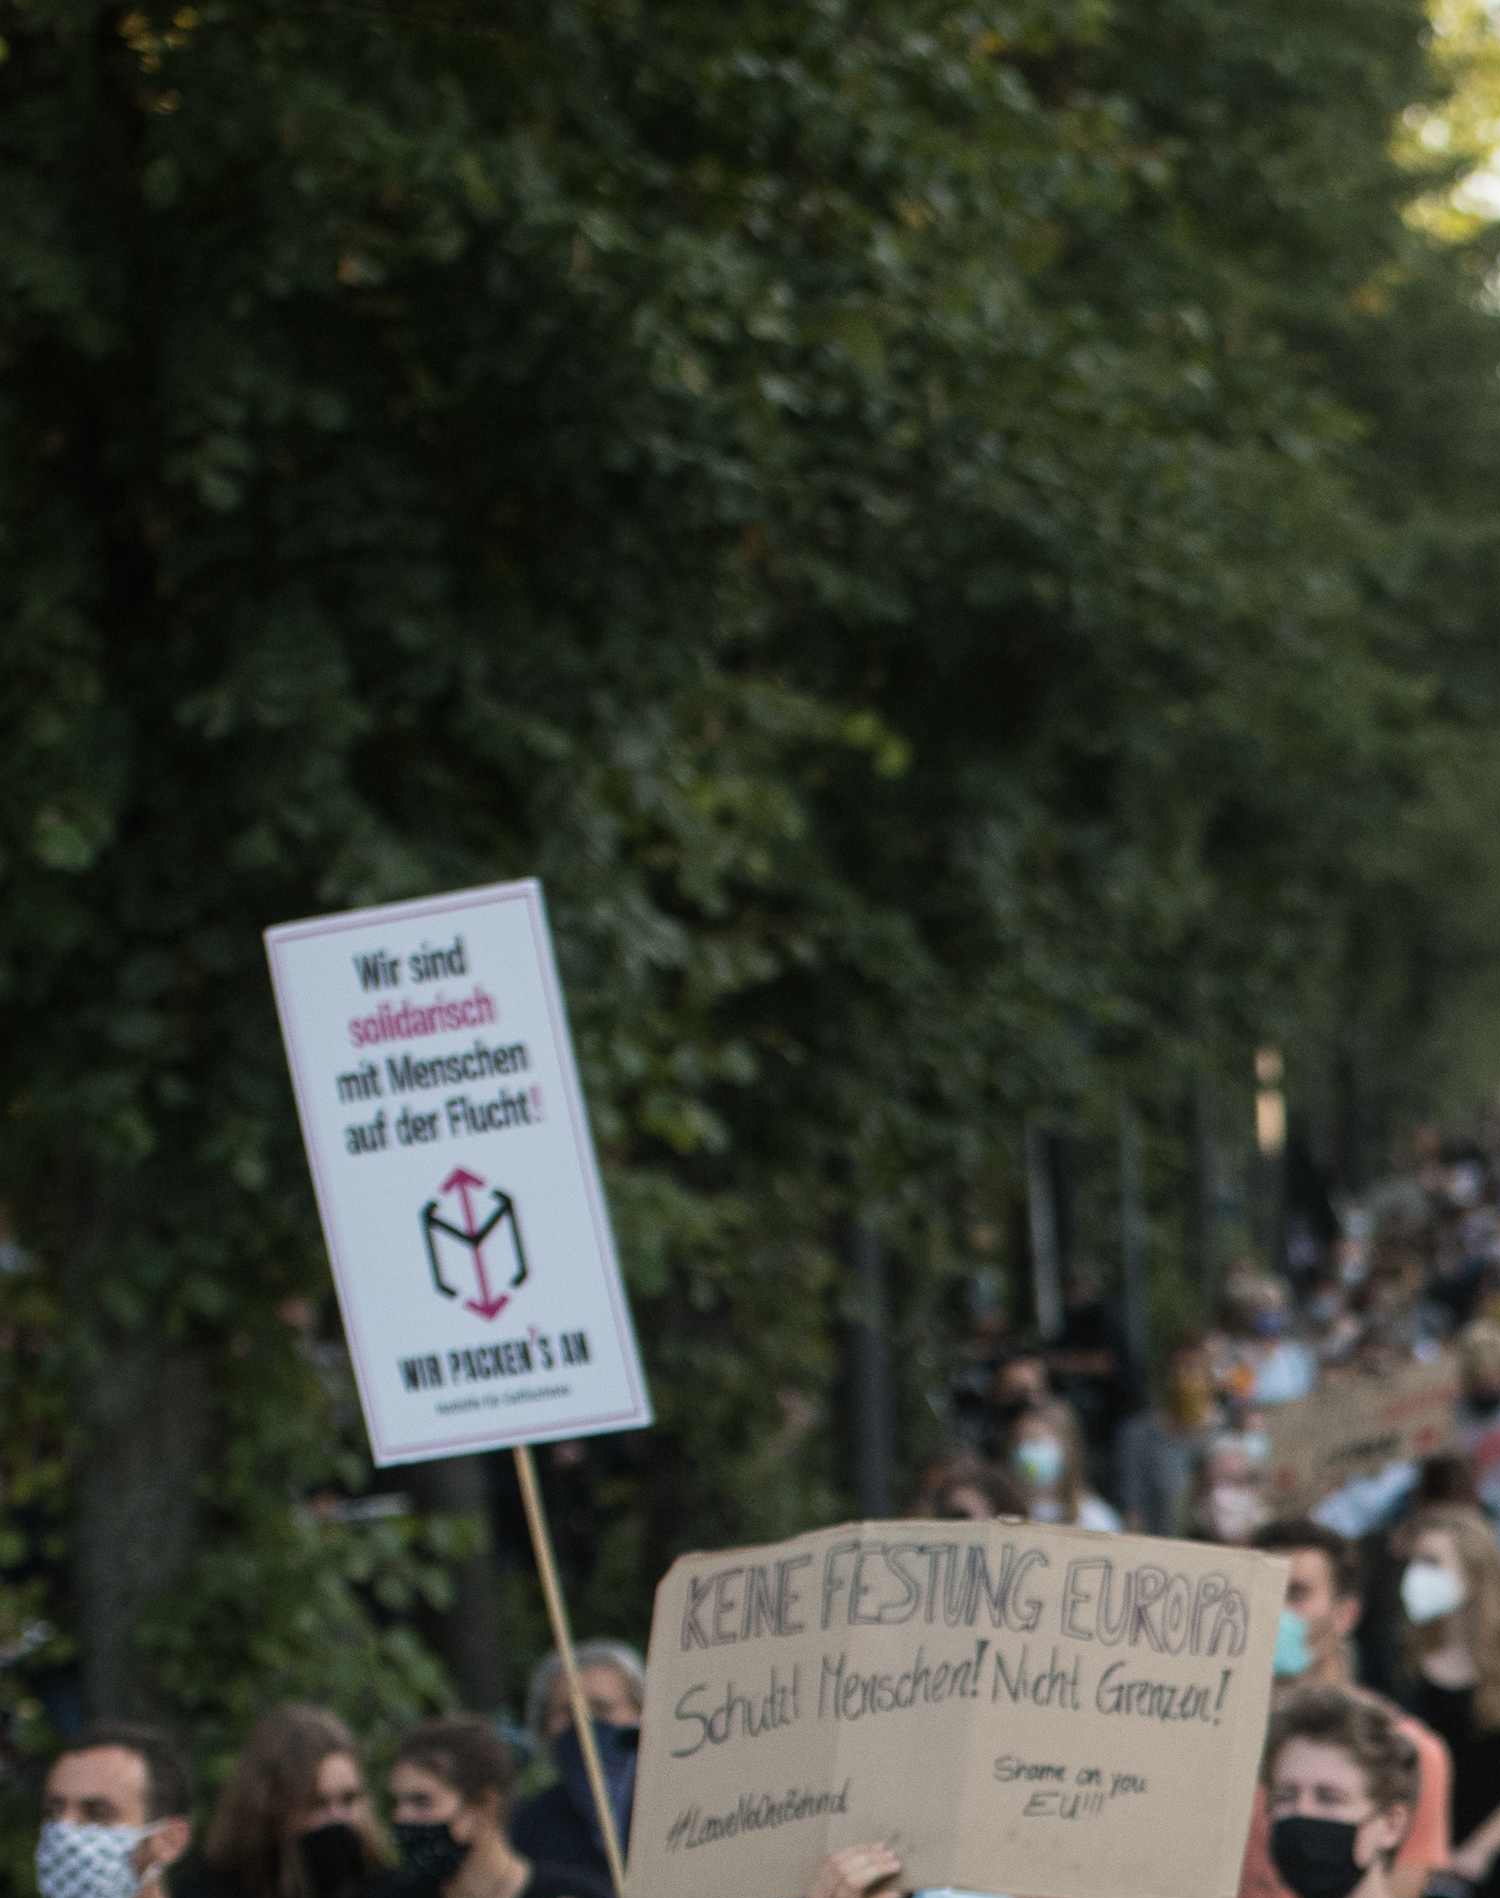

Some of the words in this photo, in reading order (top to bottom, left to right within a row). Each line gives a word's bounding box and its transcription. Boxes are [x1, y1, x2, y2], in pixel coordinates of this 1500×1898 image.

[352, 948, 400, 993] Wir
[409, 934, 467, 984] sind
[348, 983, 496, 1049] solidarisch
[336, 1058, 382, 1104] mit
[384, 1038, 529, 1095] Menschen
[344, 1107, 389, 1156] auf
[396, 1104, 439, 1147] der
[445, 1083, 545, 1139] Flucht!
[399, 1353, 443, 1393] WIR
[559, 1329, 591, 1365] AN
[681, 1551, 812, 1652] KEINE
[819, 1540, 1049, 1634] FESTUNG
[1060, 1558, 1251, 1660] EUROPA
[817, 1638, 989, 1722] Menschen!
[991, 1648, 1081, 1713] Nicht
[1096, 1663, 1234, 1729] Grenzen!
[993, 1755, 1066, 1784] Shame
